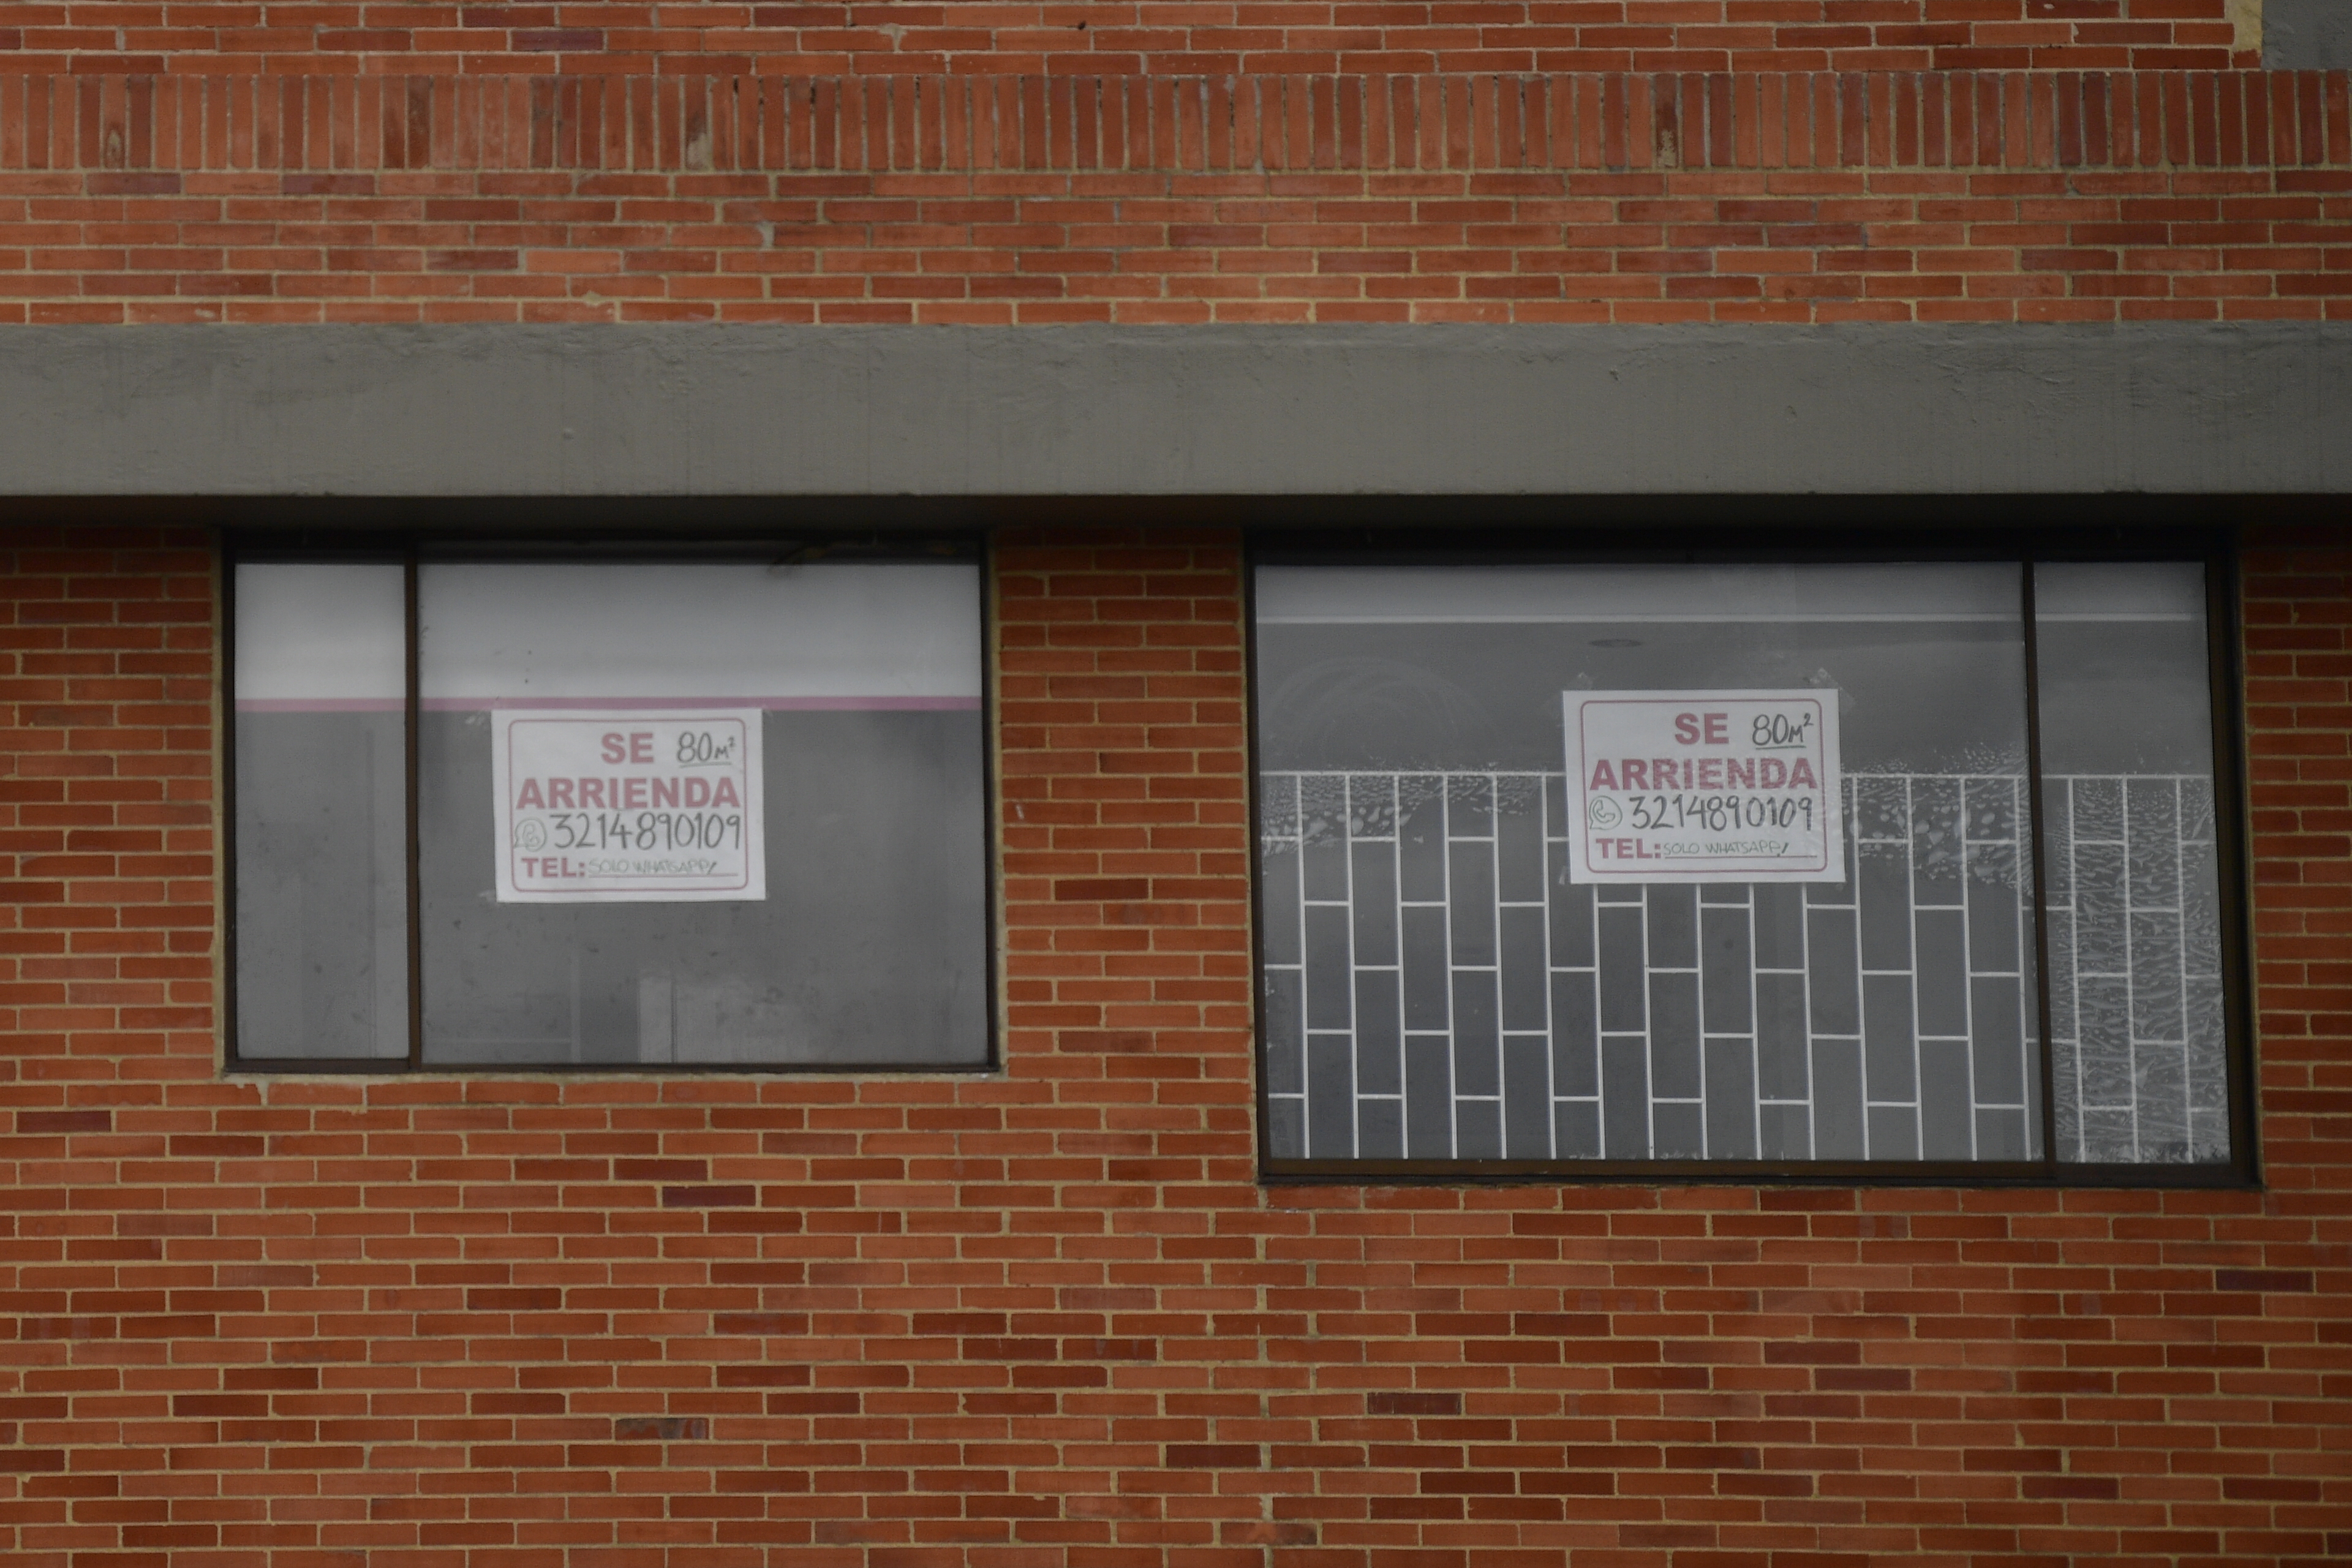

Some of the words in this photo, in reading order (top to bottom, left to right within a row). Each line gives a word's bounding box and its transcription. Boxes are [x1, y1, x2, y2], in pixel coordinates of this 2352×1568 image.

[1675, 713, 1729, 745] SE
[601, 731, 655, 764] SE
[1589, 757, 1817, 791] ARRIENDA
[516, 777, 741, 810] ARRIENDA
[1629, 794, 1812, 832] 3214890109
[550, 812, 741, 851] 3214890109
[1596, 838, 1662, 859] TEL:
[1664, 842, 1700, 856] SOLO
[521, 857, 585, 878] TEL:
[588, 859, 630, 873] SOLO
